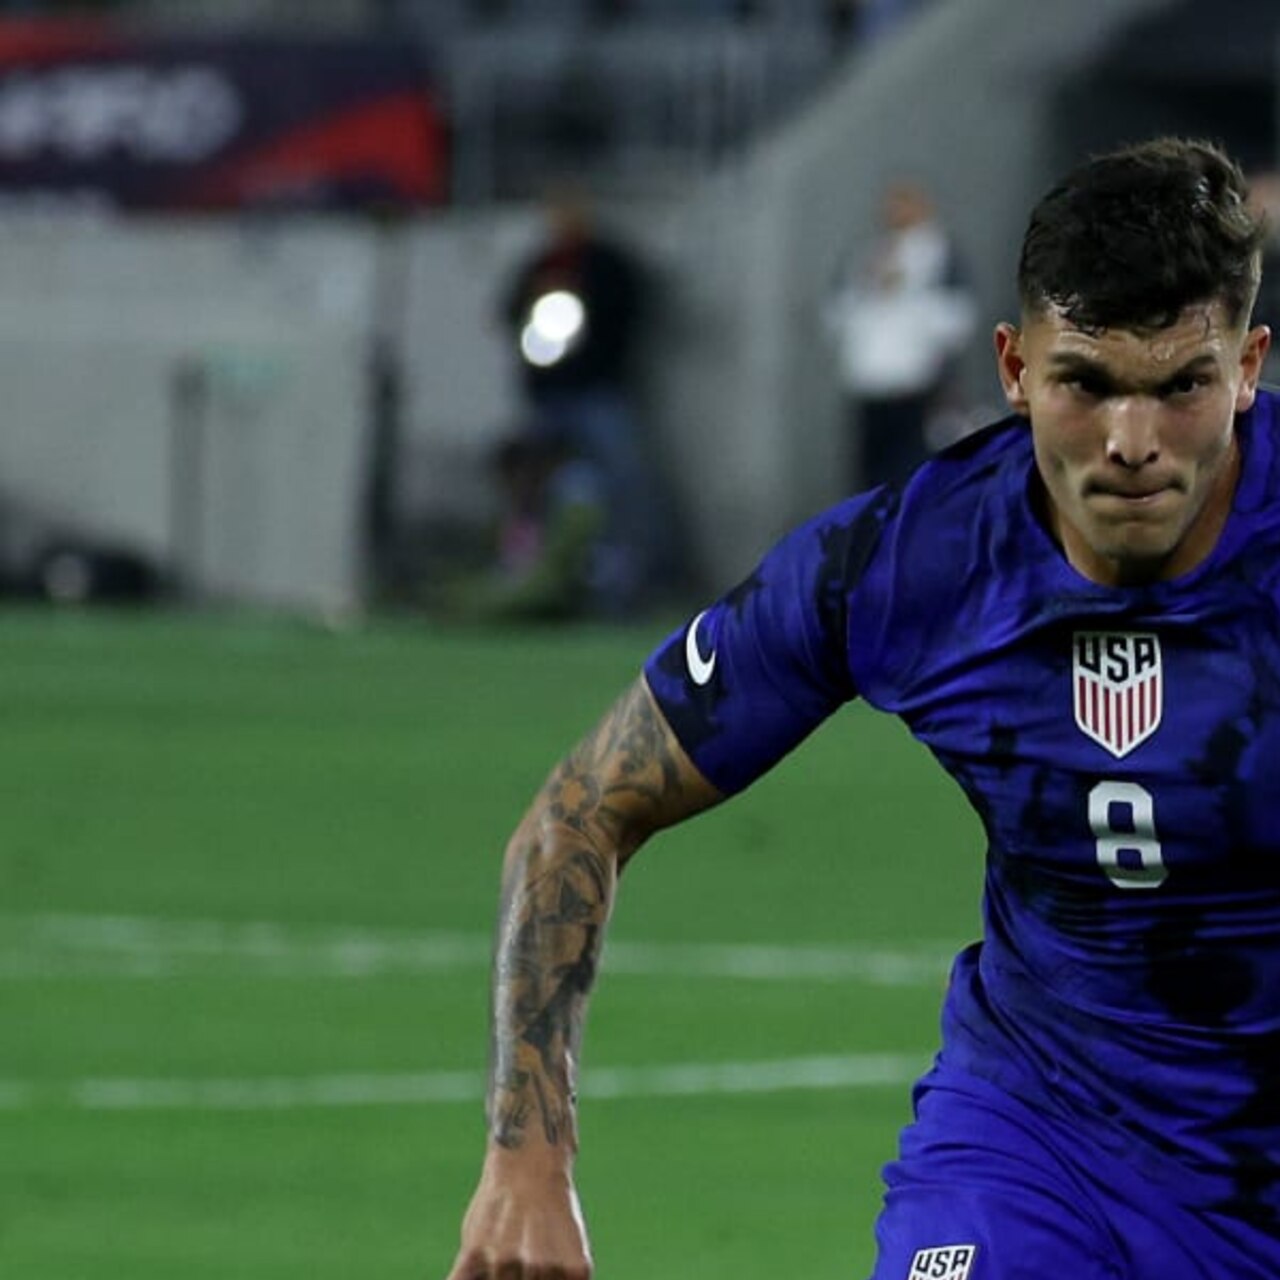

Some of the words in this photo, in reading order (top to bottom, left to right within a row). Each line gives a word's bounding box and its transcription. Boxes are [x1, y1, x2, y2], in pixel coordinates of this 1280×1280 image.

[1077, 634, 1159, 683] USA
[1086, 779, 1170, 890] 8
[913, 1246, 970, 1279] USA
